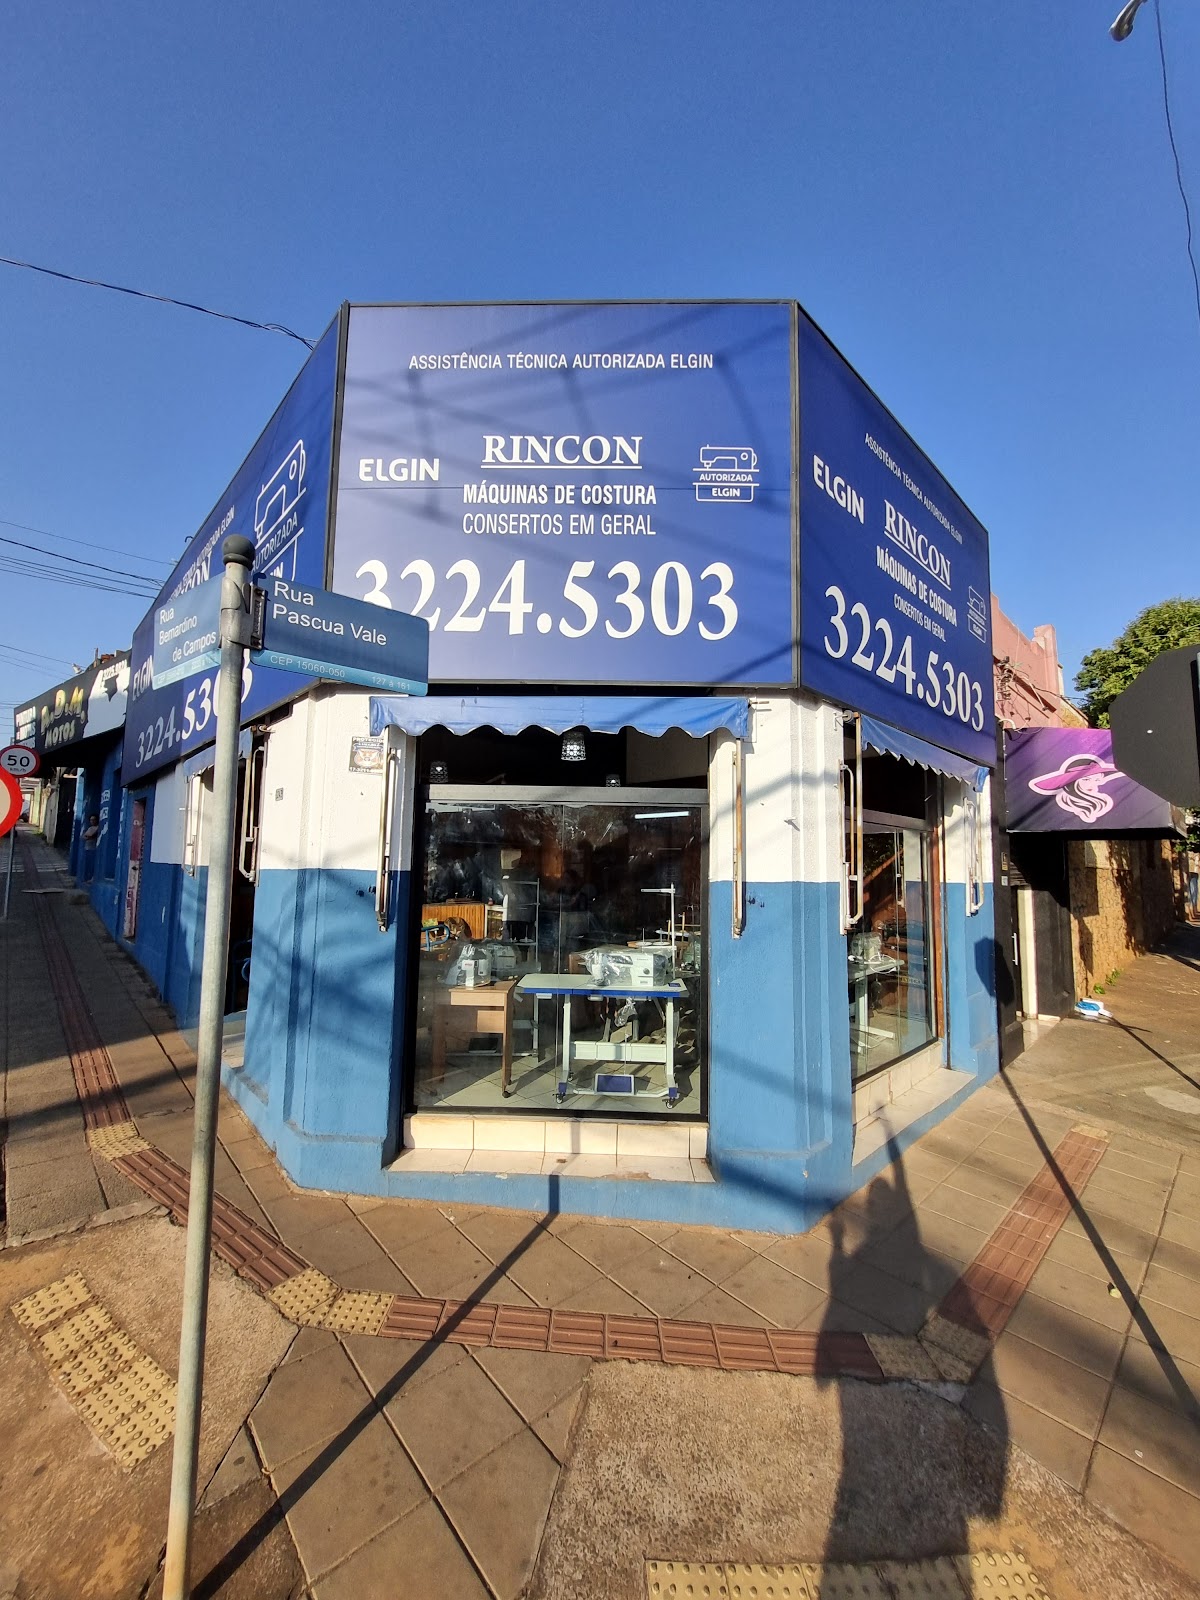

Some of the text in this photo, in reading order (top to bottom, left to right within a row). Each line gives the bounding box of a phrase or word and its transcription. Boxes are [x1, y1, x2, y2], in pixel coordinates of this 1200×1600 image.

[409, 353, 713, 369] ASSISTÊNCIA TÉCNICA AUTORIZADA ELGIN
[482, 435, 643, 465] RINCON
[358, 457, 440, 482] ELGIN
[699, 473, 753, 482] AUTORIZADA
[463, 480, 657, 505] MÁQUINAS DE COSTURA
[711, 487, 741, 497] ELGIN
[813, 454, 864, 524] ELGIN
[462, 513, 656, 535] CONSERTOS EM GERAL
[251, 511, 298, 576] AUTORIZADA
[884, 499, 951, 586] RINCON
[273, 581, 314, 606] Rua
[877, 545, 957, 627] MÁQUINAS DE COSTURA
[355, 559, 739, 641] 3224.5303
[160, 607, 175, 625] Rua
[273, 603, 387, 646] Pascua Vale
[894, 593, 946, 642] CONSERTOS EM GERAL
[172, 646, 181, 662] de
[183, 631, 217, 656] Campos
[824, 585, 984, 732] 3224.5303
[270, 655, 293, 666] CEP
[371, 676, 386, 686] 127
[45, 719, 76, 748] MOTOS
[7, 755, 30, 767] 50
